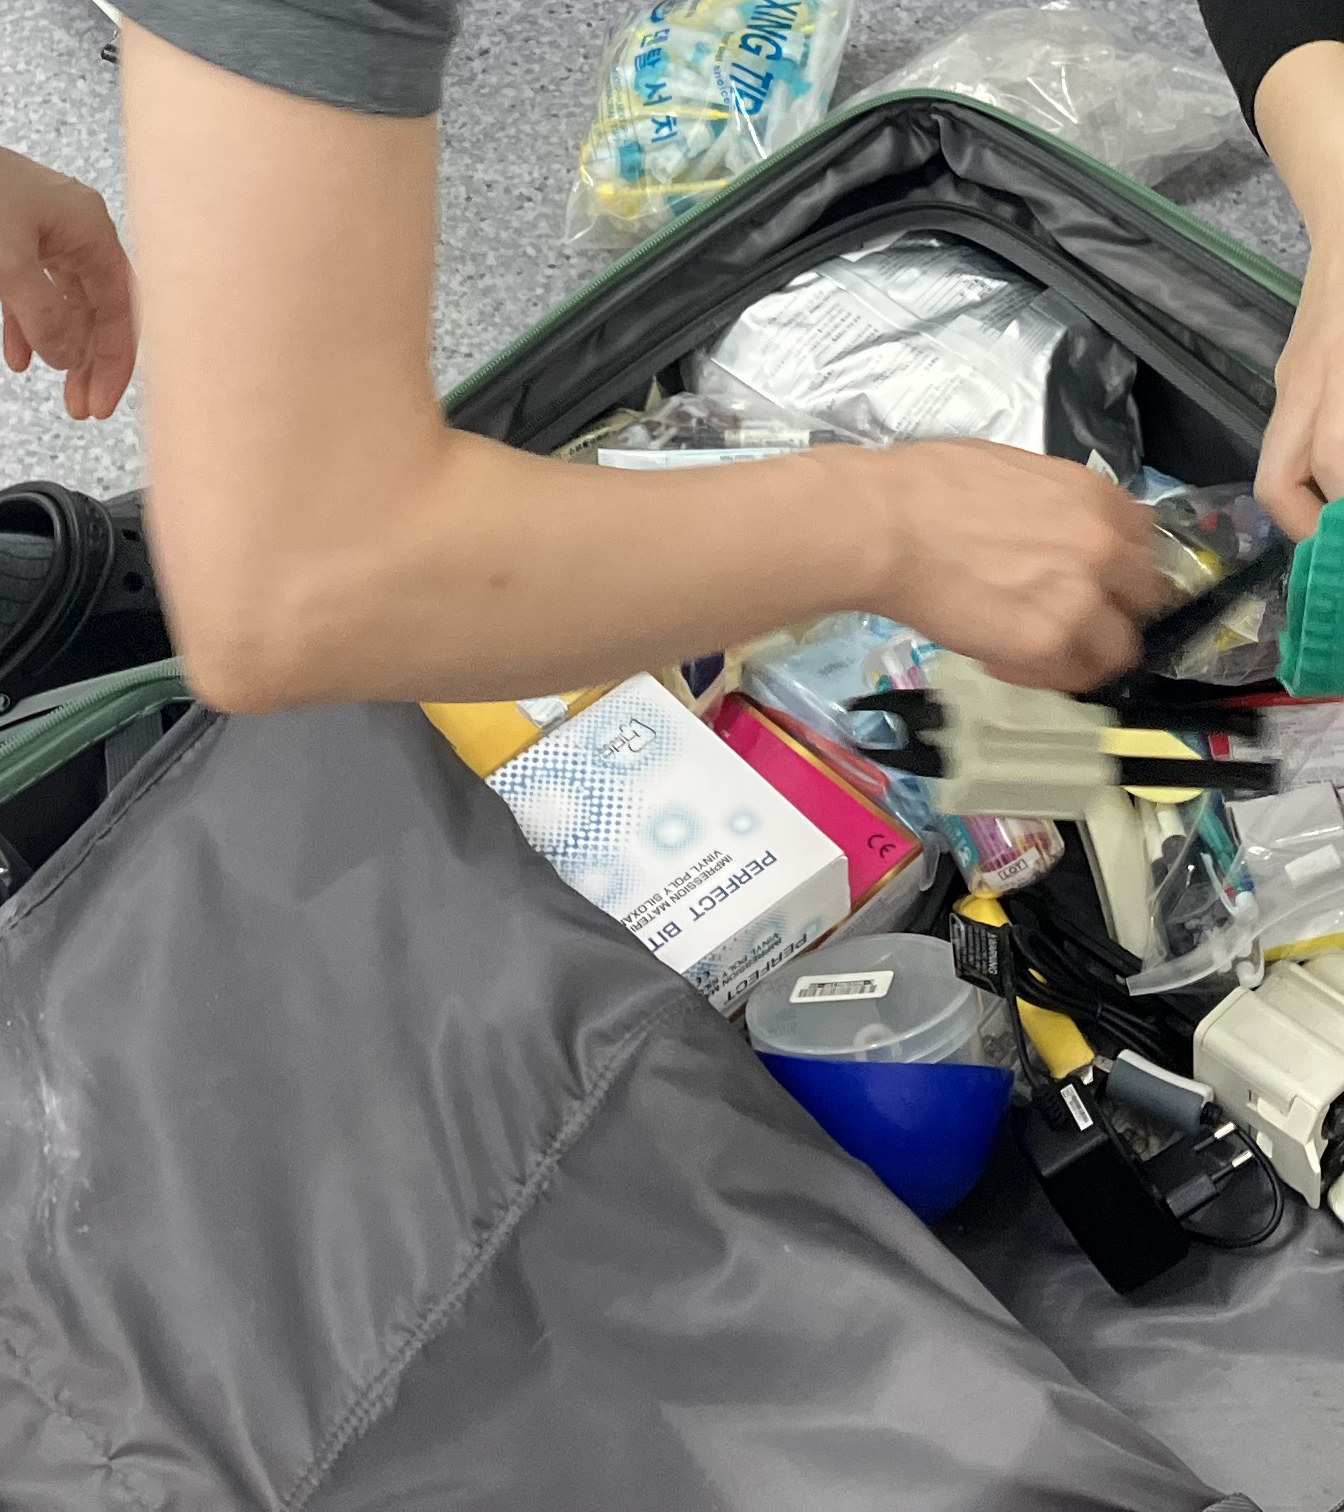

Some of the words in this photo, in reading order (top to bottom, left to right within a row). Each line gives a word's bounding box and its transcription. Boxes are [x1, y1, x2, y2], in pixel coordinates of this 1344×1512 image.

[729, 61, 774, 117] TIP
[663, 871, 693, 896] POLY
[670, 854, 734, 904] IMPRESSION
[688, 850, 778, 922] PERFECT
[689, 849, 723, 872] VINYL
[724, 932, 807, 1006] PERFECT
